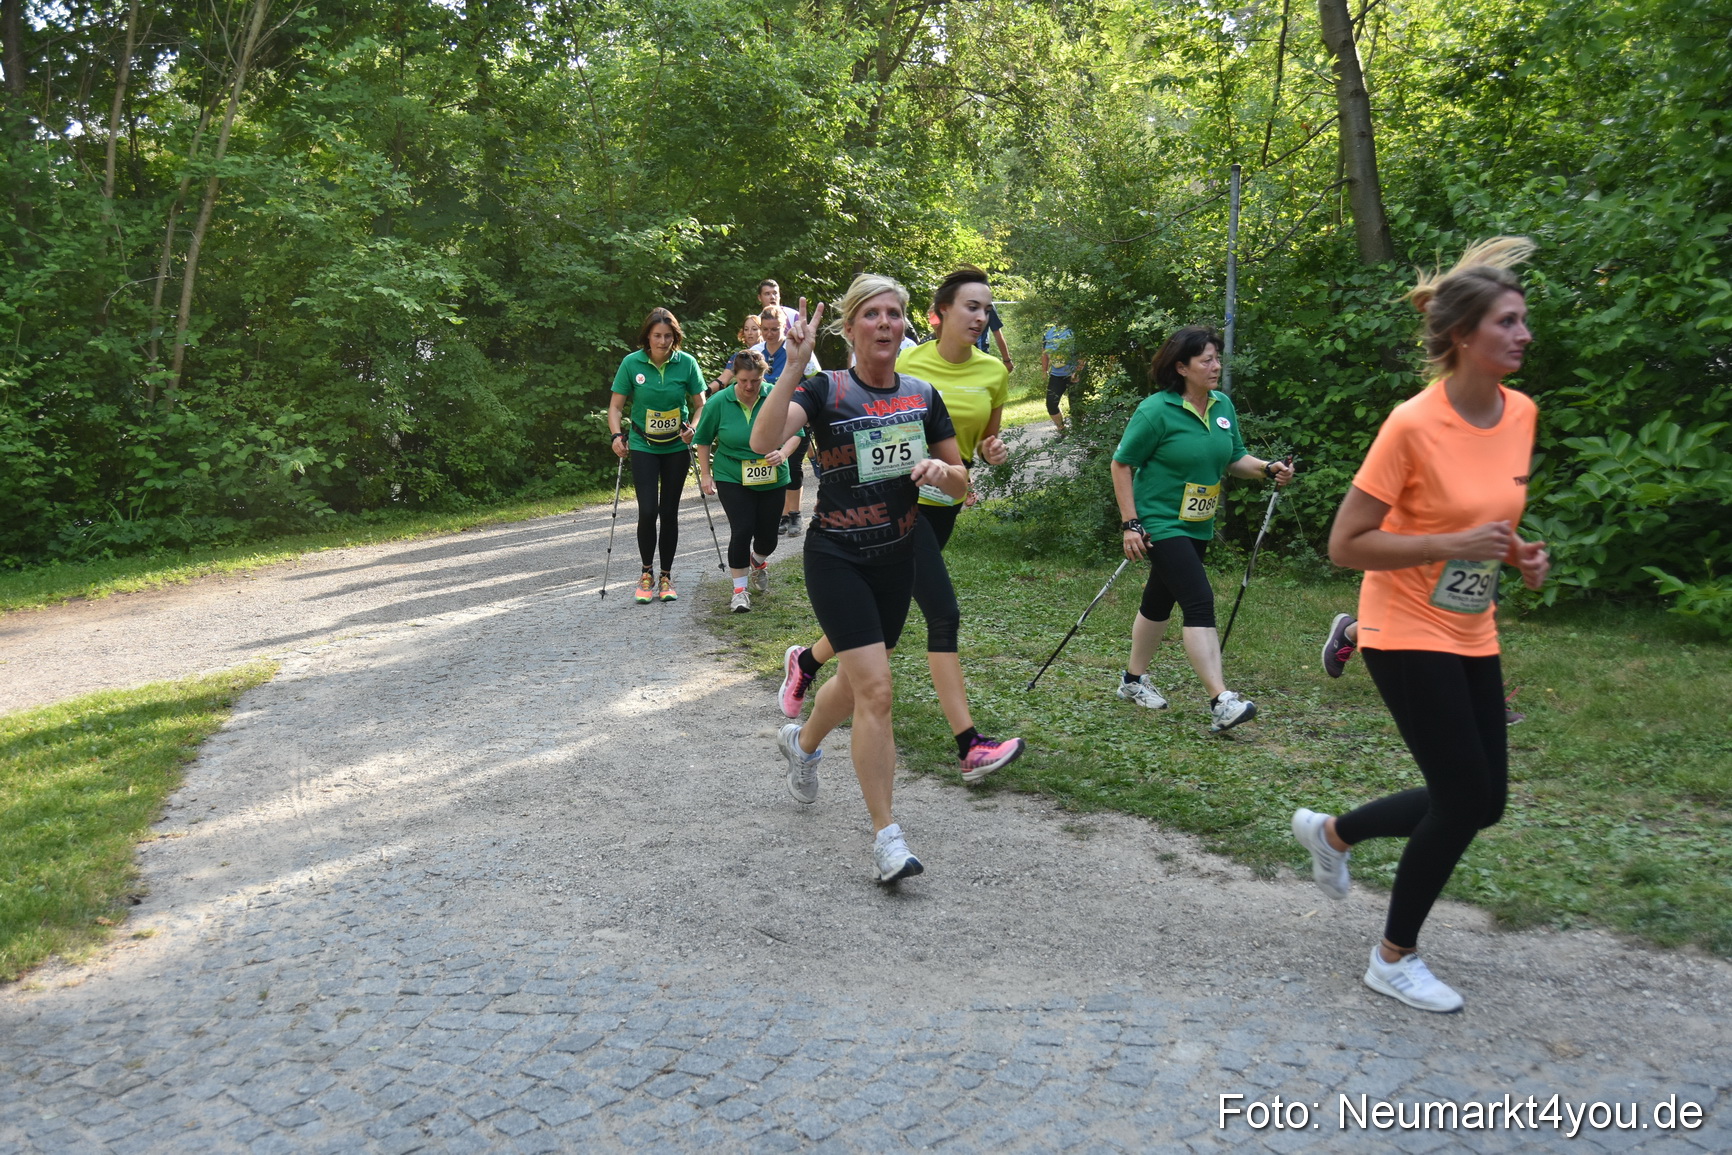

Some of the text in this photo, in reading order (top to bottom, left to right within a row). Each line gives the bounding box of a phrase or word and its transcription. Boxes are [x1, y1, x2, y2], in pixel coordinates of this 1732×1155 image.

[862, 394, 927, 415] HAARE
[650, 418, 676, 428] 2083
[872, 442, 911, 465] 975
[746, 466, 772, 477] 2087
